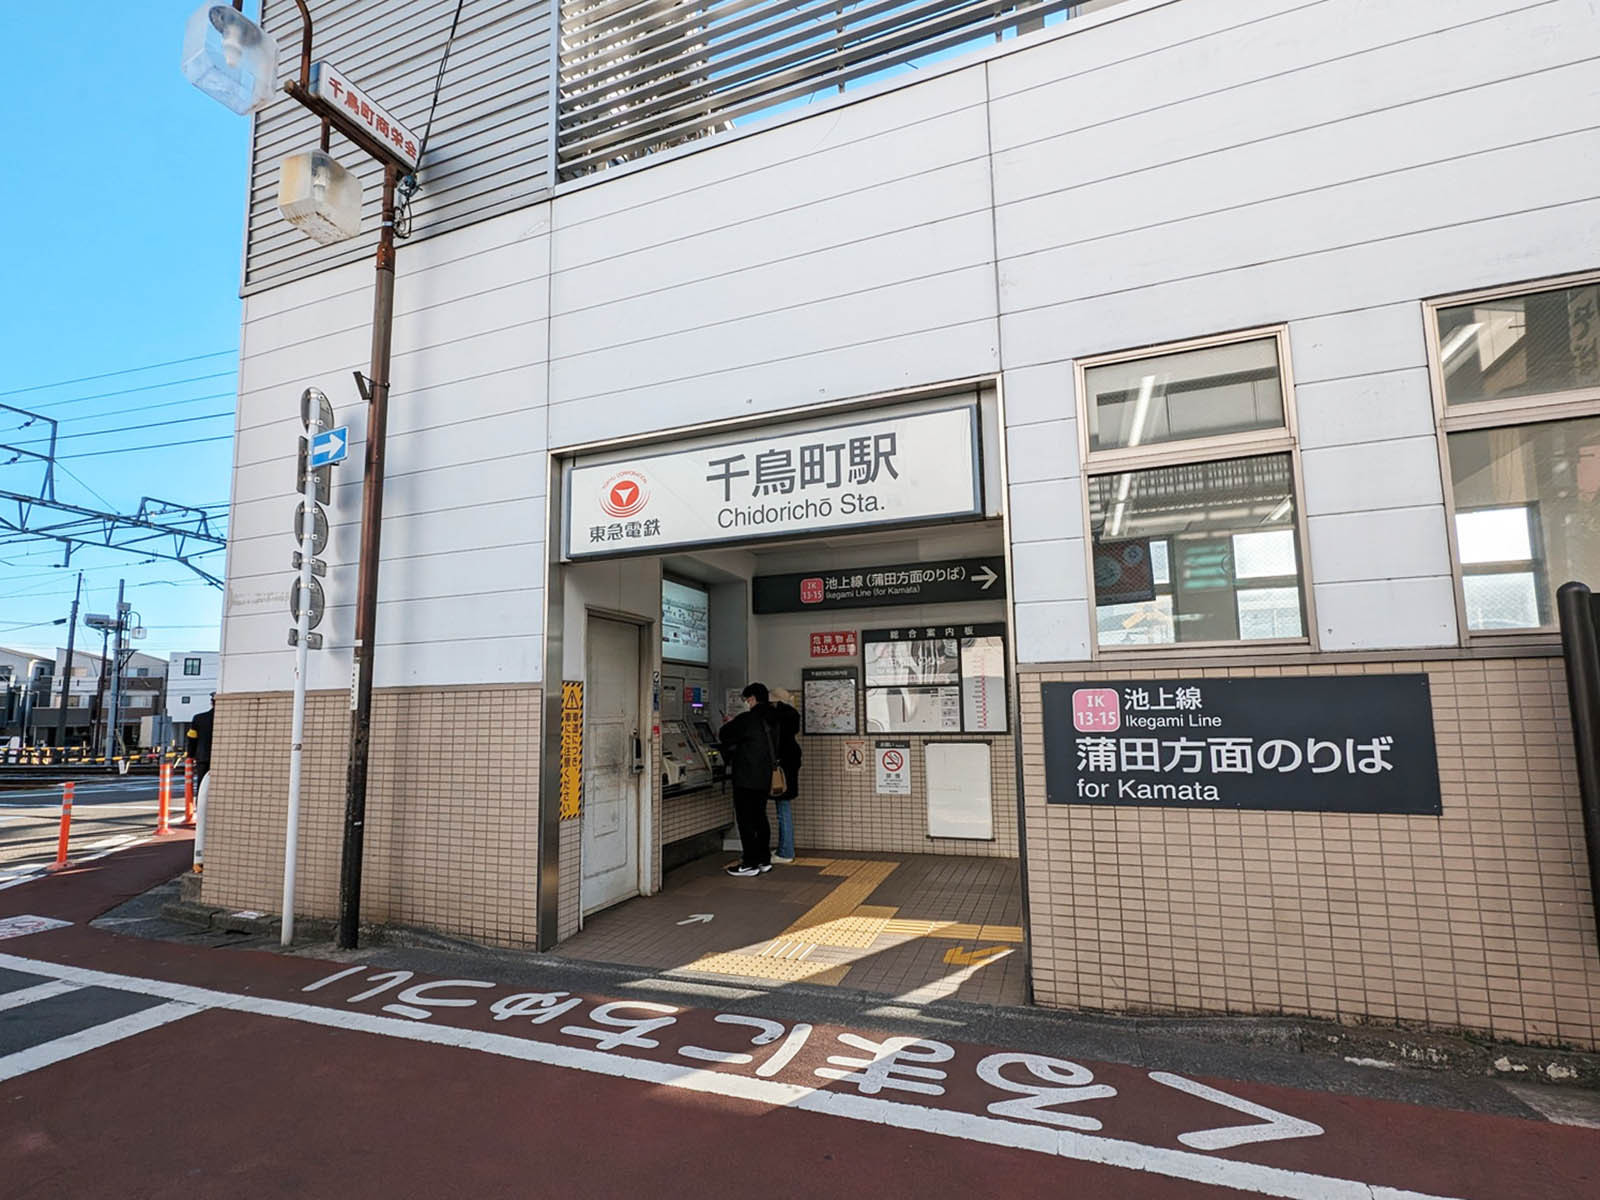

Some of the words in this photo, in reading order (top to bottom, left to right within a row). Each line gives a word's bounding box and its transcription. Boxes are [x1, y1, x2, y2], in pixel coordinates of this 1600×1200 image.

[328, 76, 417, 161] 千鳥町商栄会
[705, 432, 899, 502] 千鳥町駅
[717, 496, 833, 530] Chidorichō
[840, 493, 885, 516] Sta.
[589, 518, 661, 543] 東急電鉄
[826, 590, 854, 600] Ikegami
[856, 589, 872, 598] Line
[873, 588, 886, 598] (for
[887, 585, 921, 595] Kamata)
[1086, 695, 1105, 708] IK
[1124, 686, 1203, 711] 池上線
[1077, 711, 1116, 726] 13-15
[1125, 714, 1184, 730] Ikegami
[1189, 714, 1222, 727] Line
[1075, 736, 1395, 774] 蒲田方面のりば
[1076, 778, 1110, 798] for
[1118, 779, 1220, 801] Kamata
[302, 965, 1325, 1150] くるまにちゅうい
